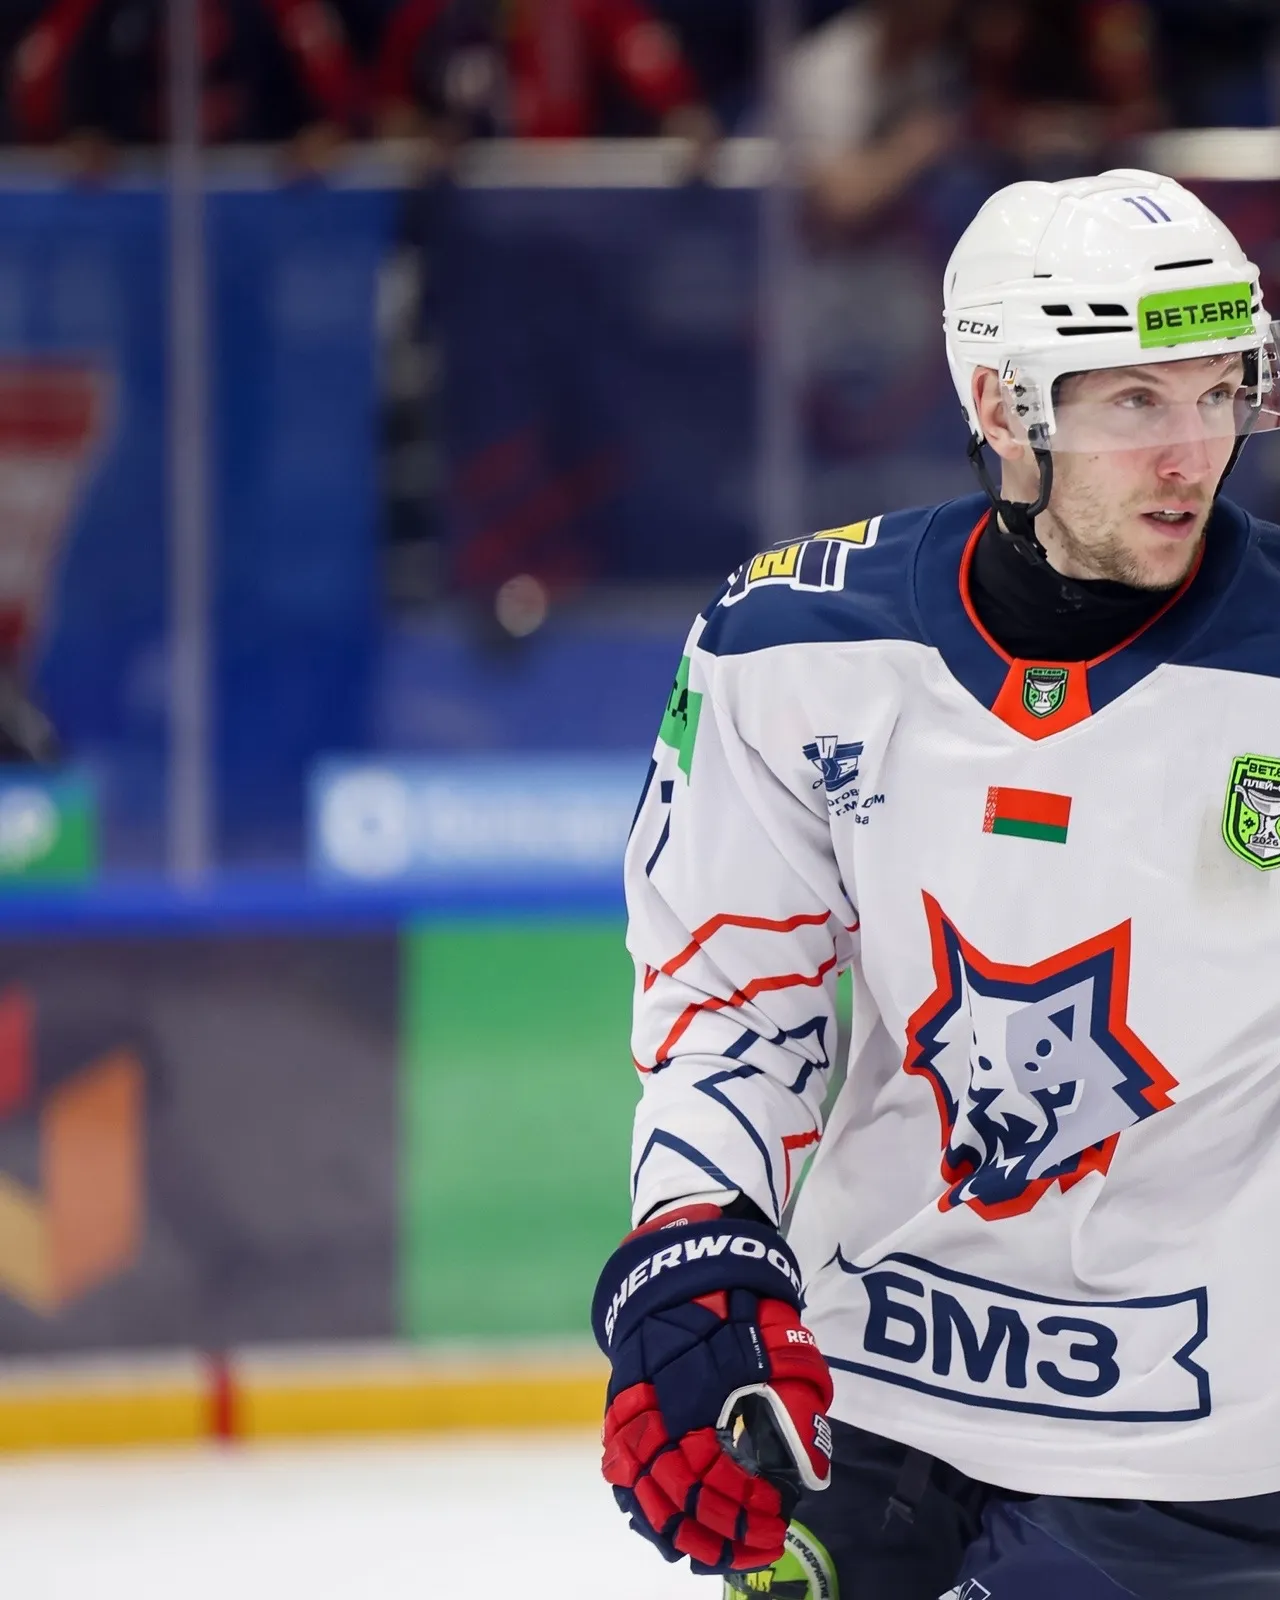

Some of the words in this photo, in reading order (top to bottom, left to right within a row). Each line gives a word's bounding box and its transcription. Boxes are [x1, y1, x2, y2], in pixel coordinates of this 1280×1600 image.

[957, 319, 999, 337] CCM
[785, 1329, 816, 1346] REK
[862, 1271, 1120, 1398] БМЗ
